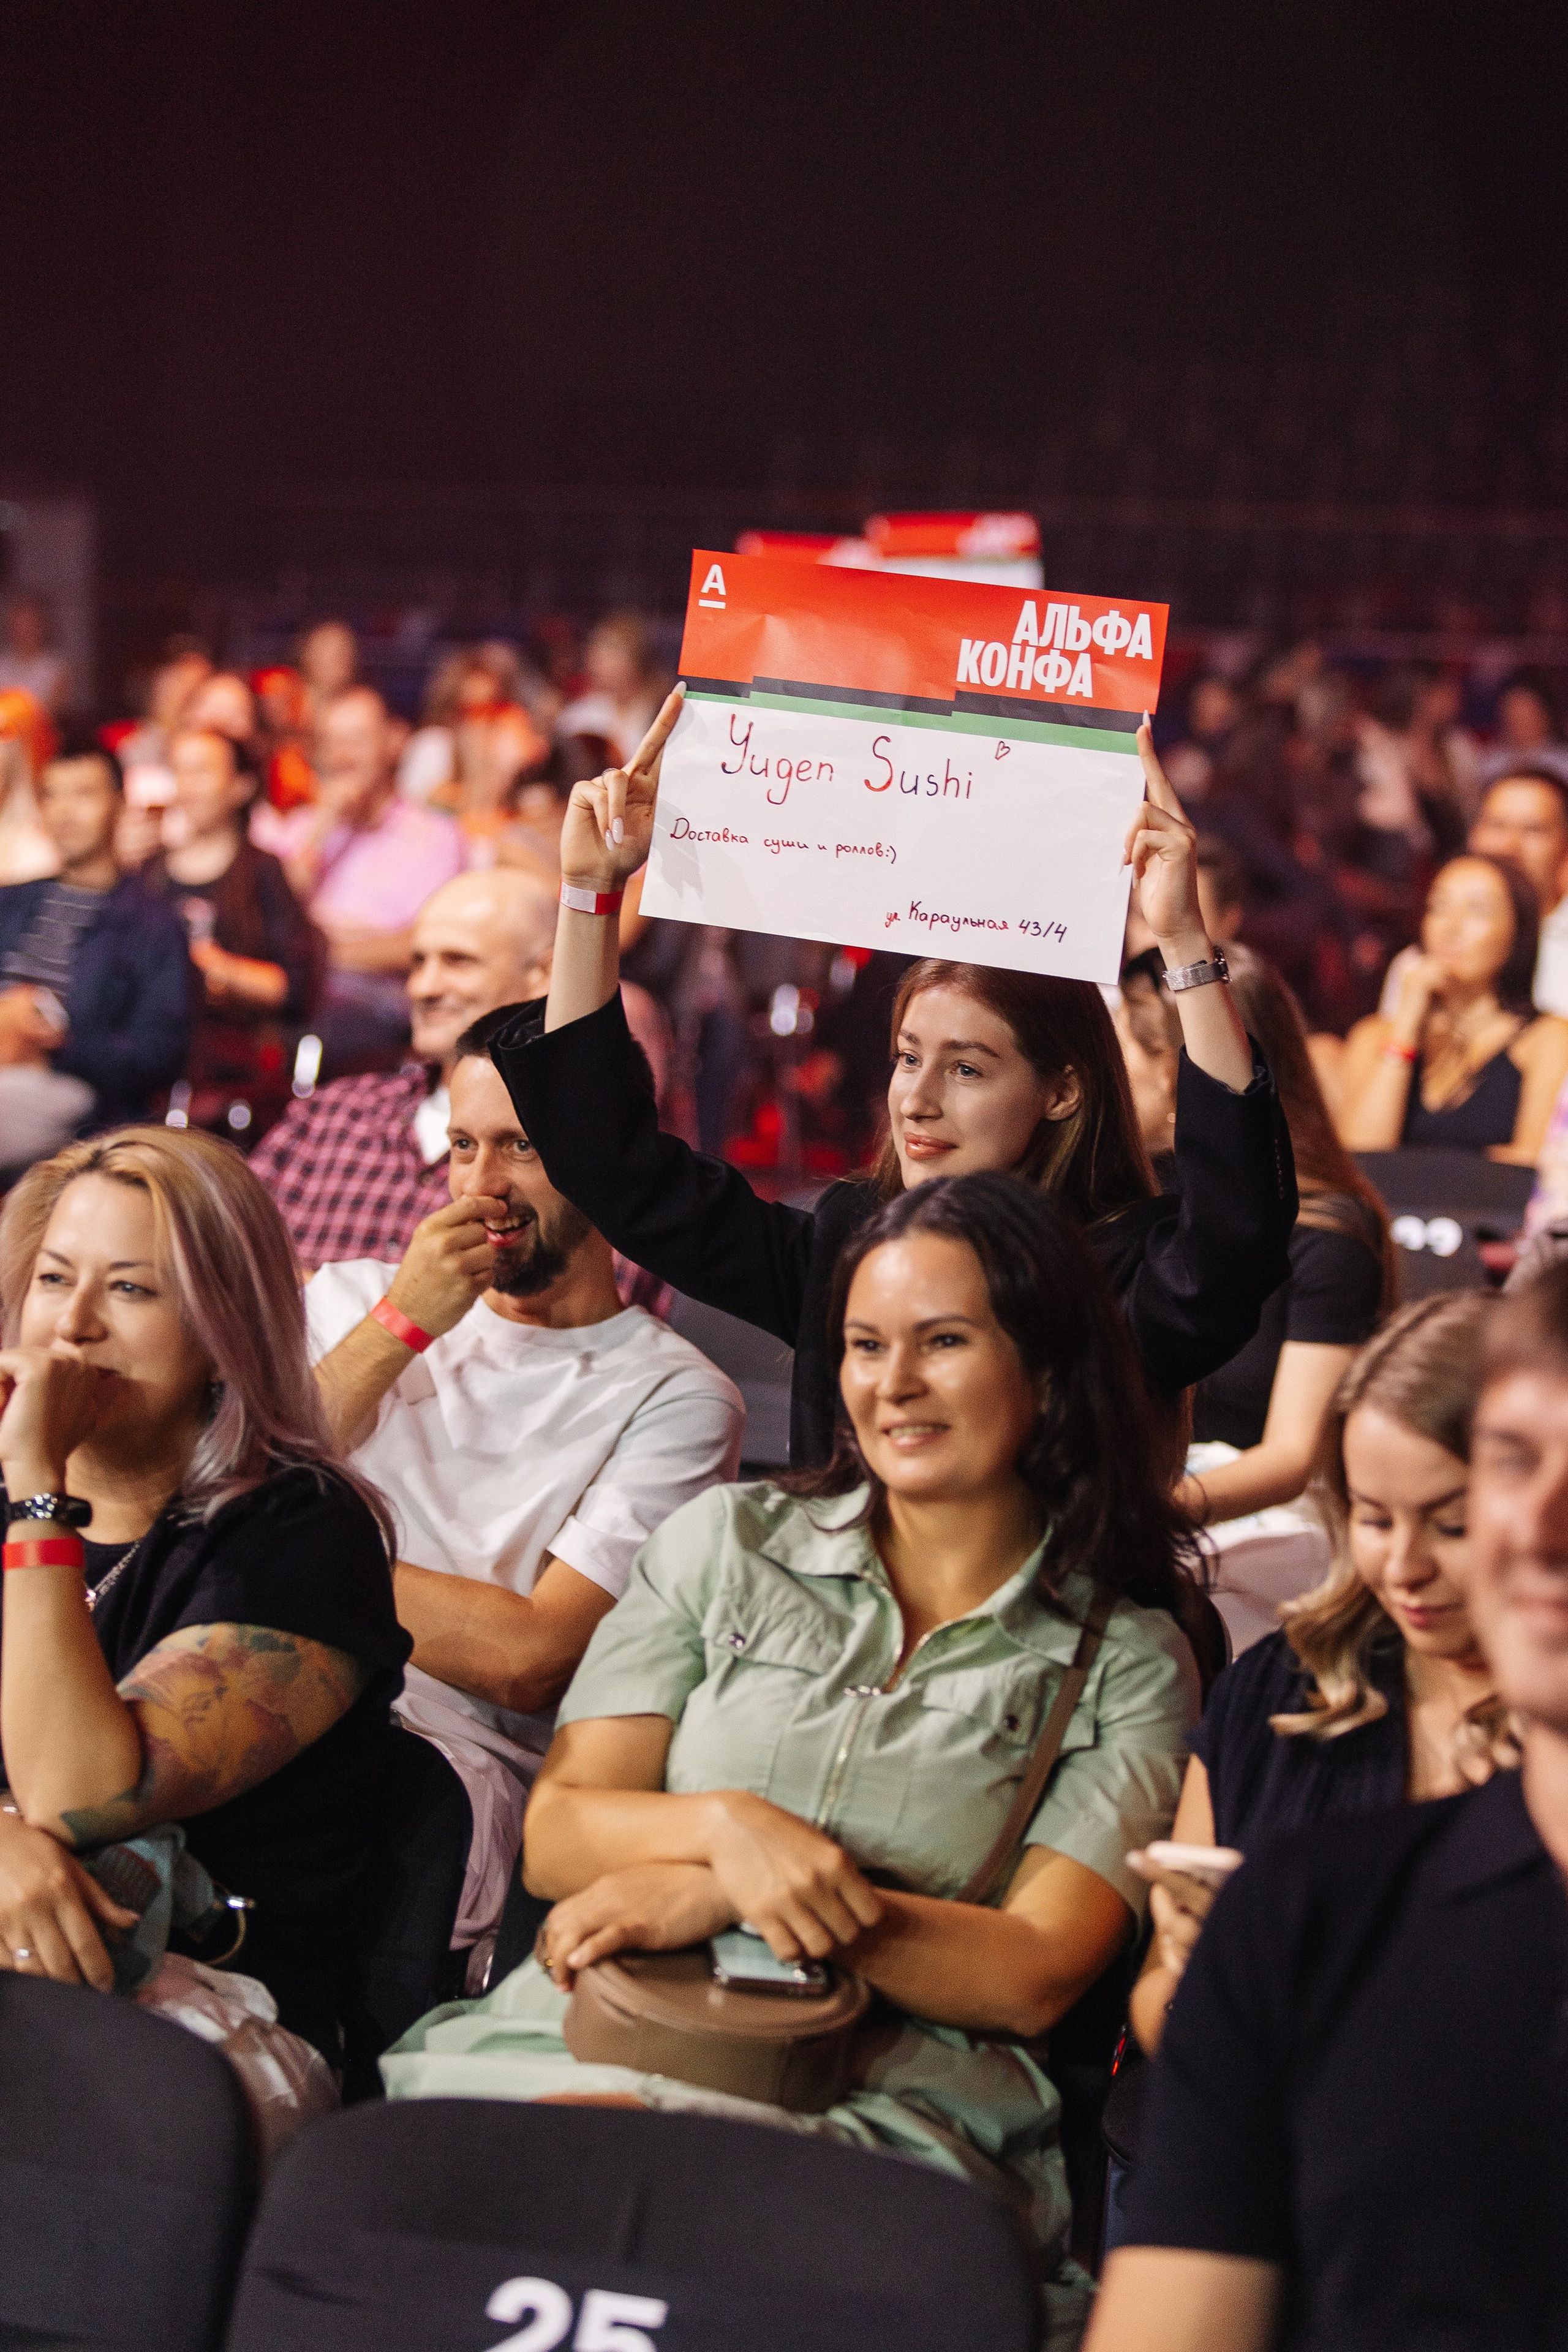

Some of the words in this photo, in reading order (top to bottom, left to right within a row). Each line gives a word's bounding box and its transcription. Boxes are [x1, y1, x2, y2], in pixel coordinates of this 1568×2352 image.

[1012, 600, 1153, 660] АЛЬФА
[956, 638, 1093, 698] КОНФА
[722, 713, 834, 805] Yugen
[864, 736, 973, 799] Sushi
[670, 817, 749, 845] Доставка
[764, 838, 810, 854] суши
[909, 900, 1009, 932] Караульная
[1019, 919, 1068, 943] 43/4
[484, 2275, 669, 2352] 25
